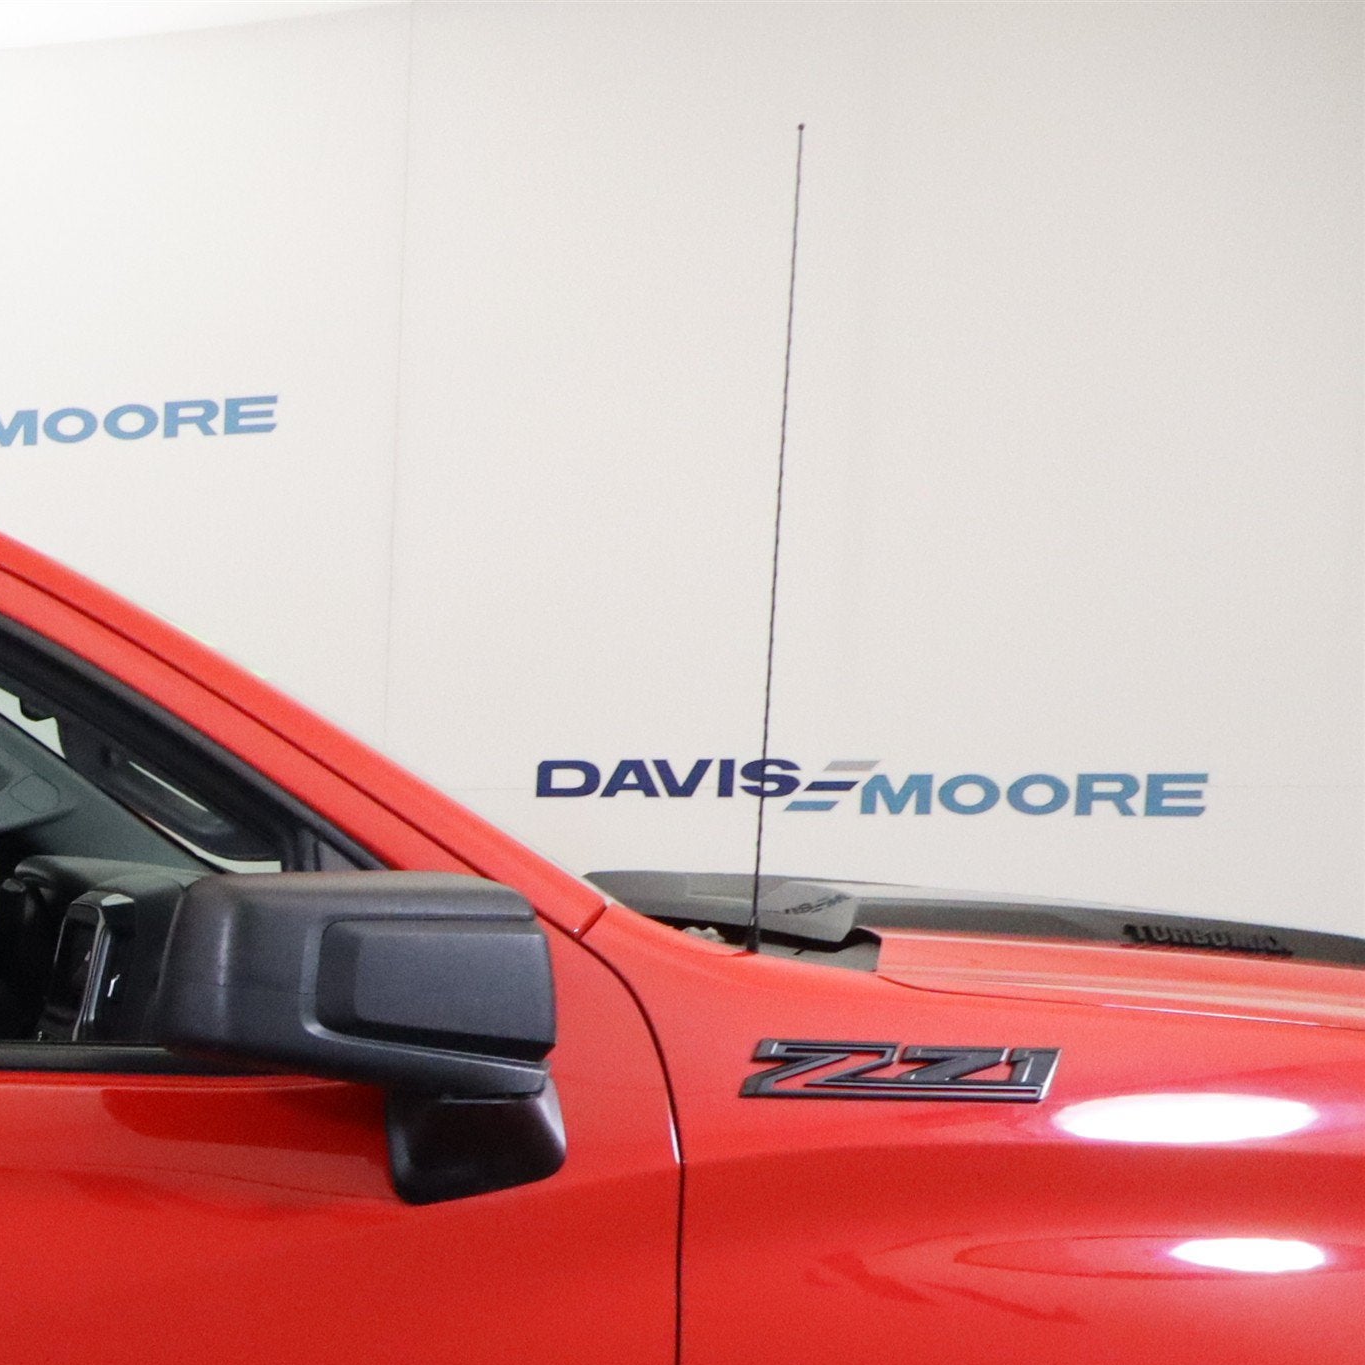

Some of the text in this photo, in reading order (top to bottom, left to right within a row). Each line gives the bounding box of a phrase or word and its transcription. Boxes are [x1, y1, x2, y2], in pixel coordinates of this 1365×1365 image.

[535, 757, 1209, 818] DAVIS MOORE
[1122, 923, 1294, 957] TURBOM
[739, 1037, 1064, 1104] Z71
